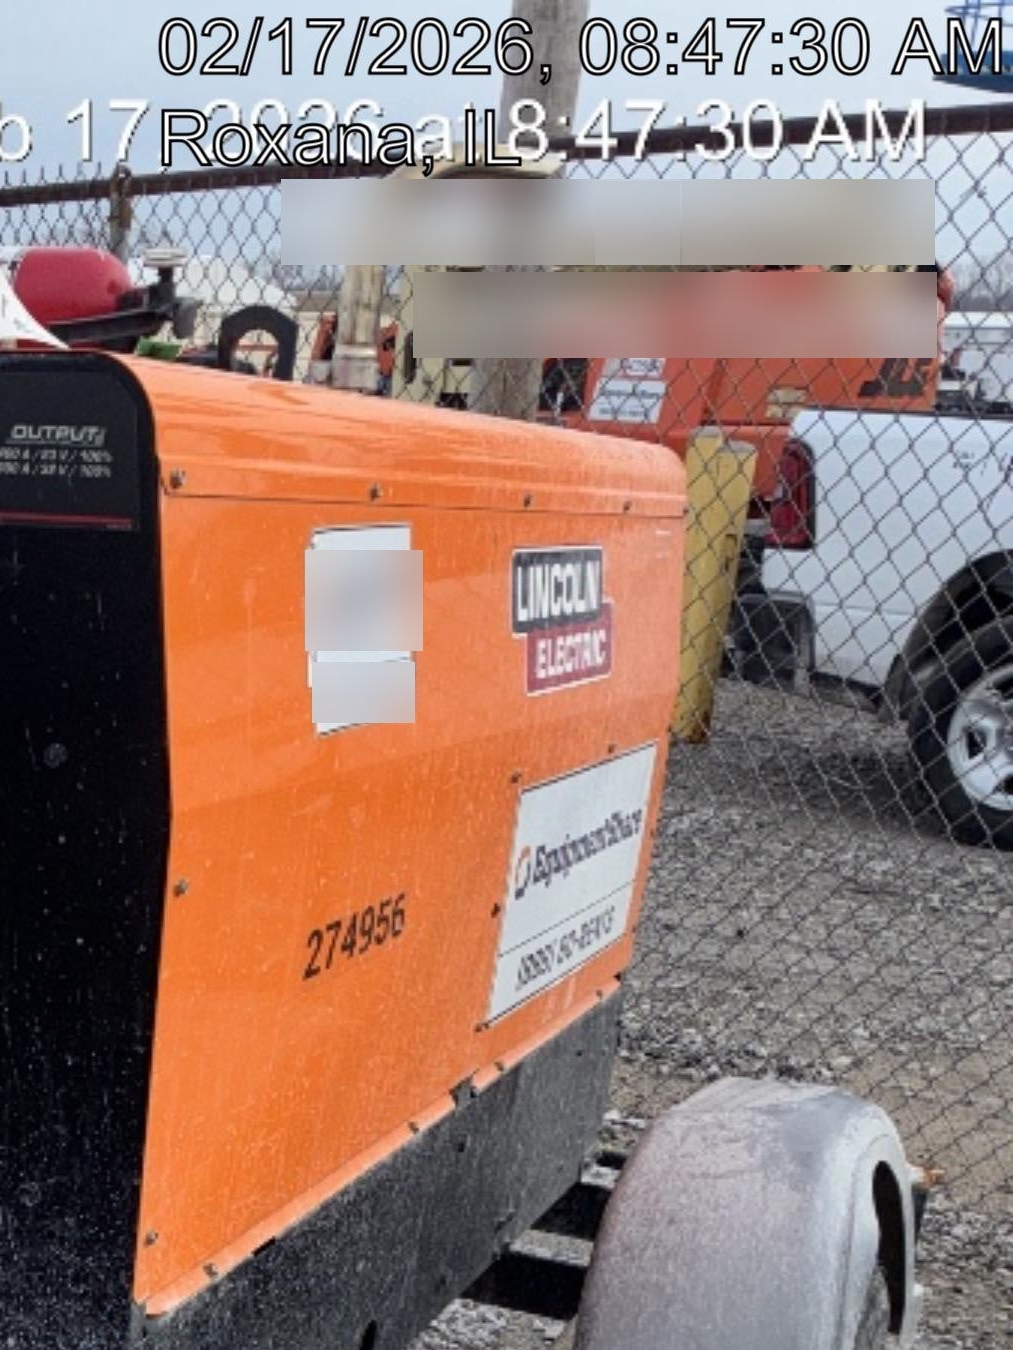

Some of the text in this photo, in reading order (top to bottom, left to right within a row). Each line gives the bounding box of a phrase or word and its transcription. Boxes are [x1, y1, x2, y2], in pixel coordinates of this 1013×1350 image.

[9, 424, 101, 442] OUTPUT
[517, 560, 600, 622] LINCOLN
[536, 630, 606, 679] ELECTRIC
[303, 893, 405, 980] 274956
